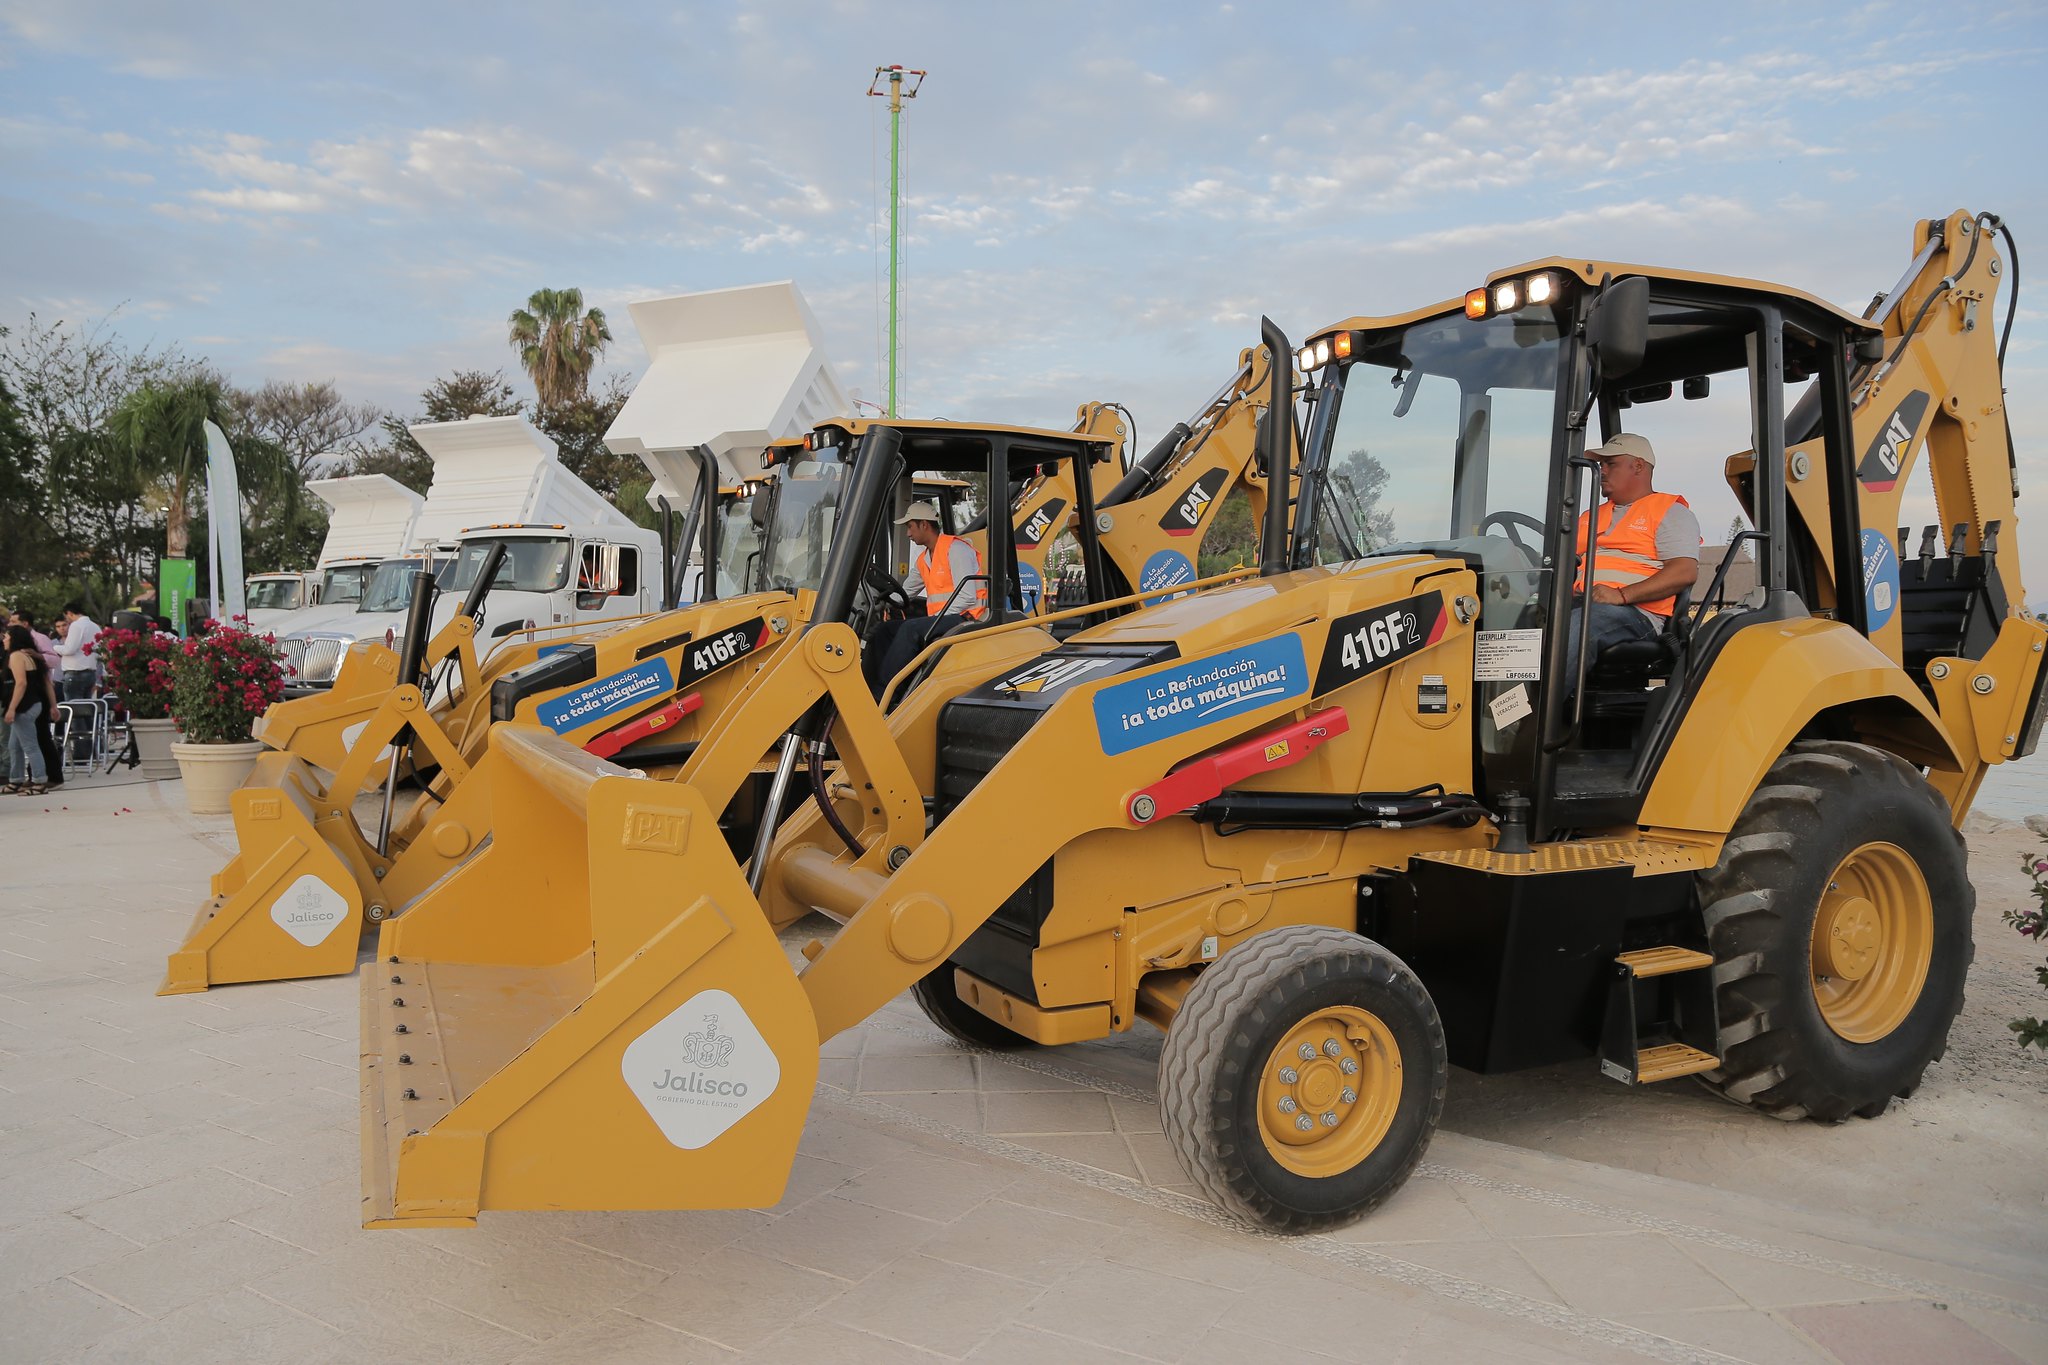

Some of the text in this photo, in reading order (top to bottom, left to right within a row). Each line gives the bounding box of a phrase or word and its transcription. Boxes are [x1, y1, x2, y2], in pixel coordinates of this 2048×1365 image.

[1878, 410, 1911, 475] CAT
[1179, 481, 1212, 525] CAT
[1025, 508, 1052, 542] CAT
[1142, 557, 1174, 589] Refundación
[1148, 568, 1156, 576] La
[693, 632, 750, 671] 416F2
[1341, 610, 1421, 670] 416F2
[1478, 633, 1507, 641] CATERPILLAR
[568, 671, 639, 707] La Refundación
[1147, 658, 1257, 701] La Refundación
[554, 672, 660, 726] ¡a toda máquina!
[1121, 664, 1288, 731] ¡a toda máquina!
[1494, 692, 1517, 709] VERACRUZ
[1496, 700, 1519, 717] VERACRUZ
[287, 911, 334, 923] Jalisco
[652, 1069, 748, 1098] Jalisco
[656, 1095, 695, 1105] GOBIERNO
[711, 1101, 739, 1109] ESTADO
